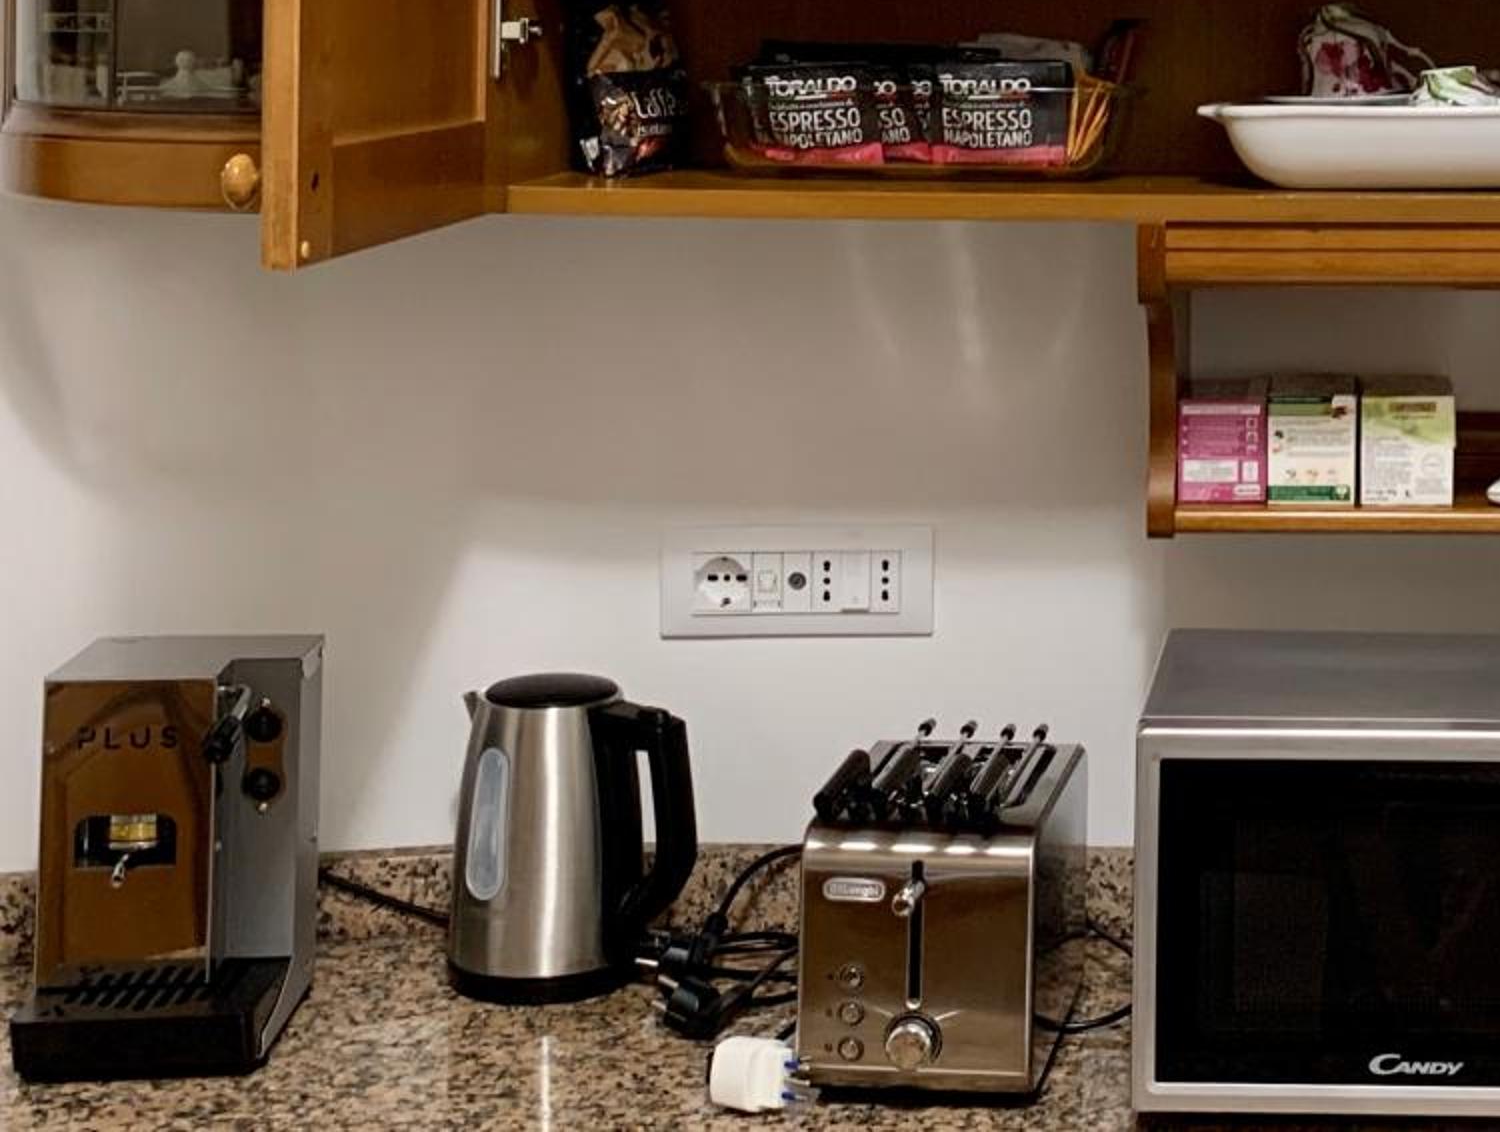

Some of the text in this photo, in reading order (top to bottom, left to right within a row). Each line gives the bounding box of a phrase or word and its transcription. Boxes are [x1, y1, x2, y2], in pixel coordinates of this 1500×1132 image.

[769, 107, 861, 133] ESPRESSO
[942, 107, 1032, 132] ESPRESSO
[944, 129, 1033, 148] NAPOLETANO
[77, 725, 178, 750] PLUS
